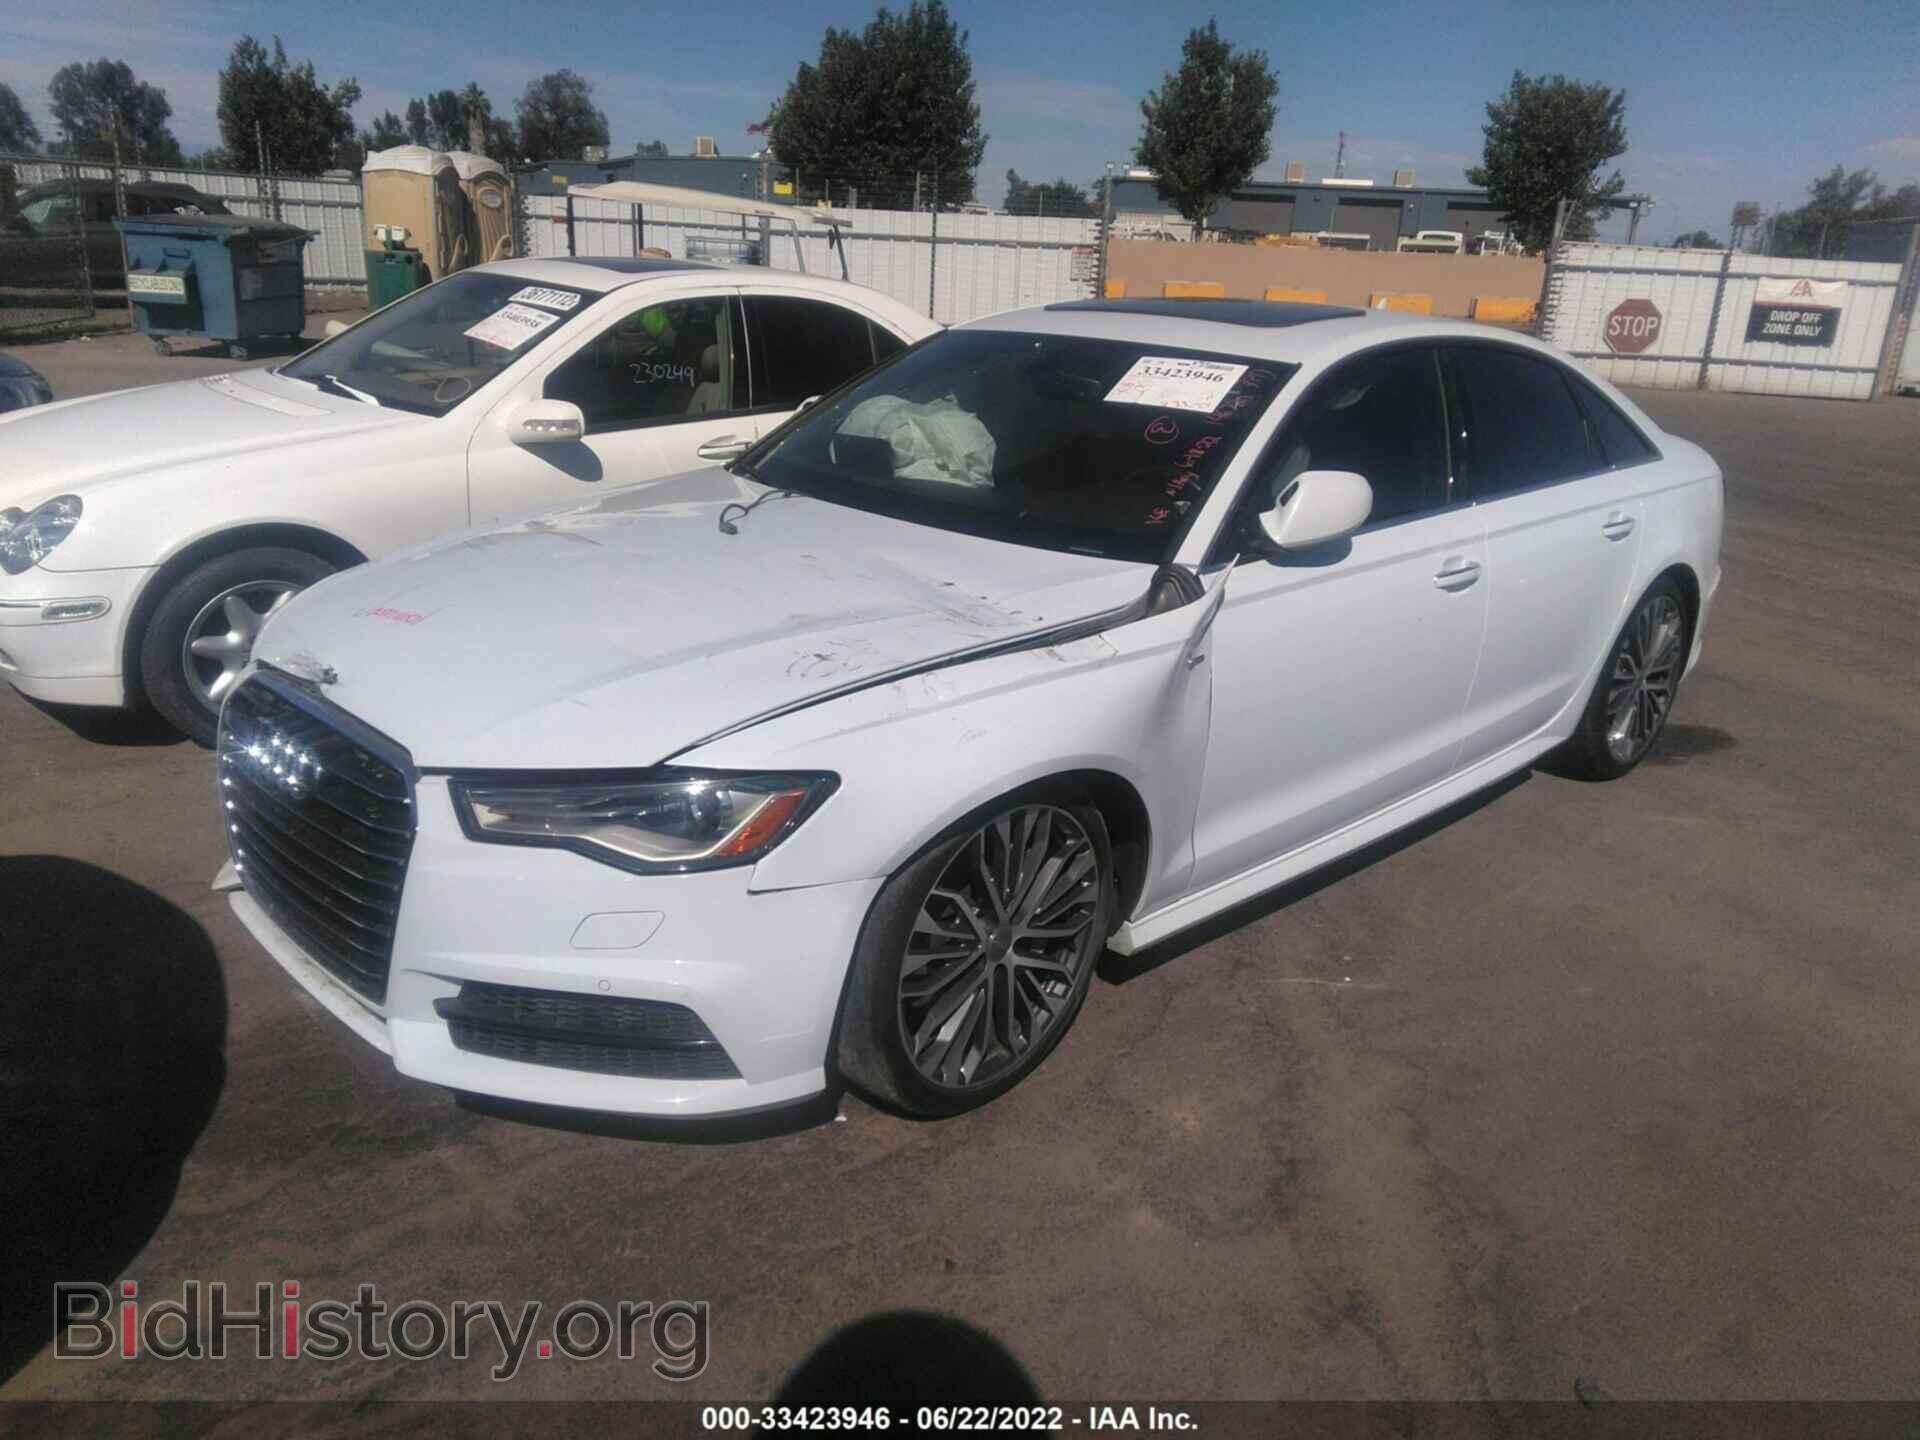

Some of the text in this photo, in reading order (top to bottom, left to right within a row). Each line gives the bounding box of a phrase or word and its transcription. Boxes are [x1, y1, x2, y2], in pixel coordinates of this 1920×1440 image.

[1770, 310, 1823, 323] DROP OFF
[1609, 315, 1658, 337] STOP
[1763, 322, 1823, 336] ZONE ONLY
[628, 362, 695, 387] 230249
[1138, 366, 1224, 383] 33423946
